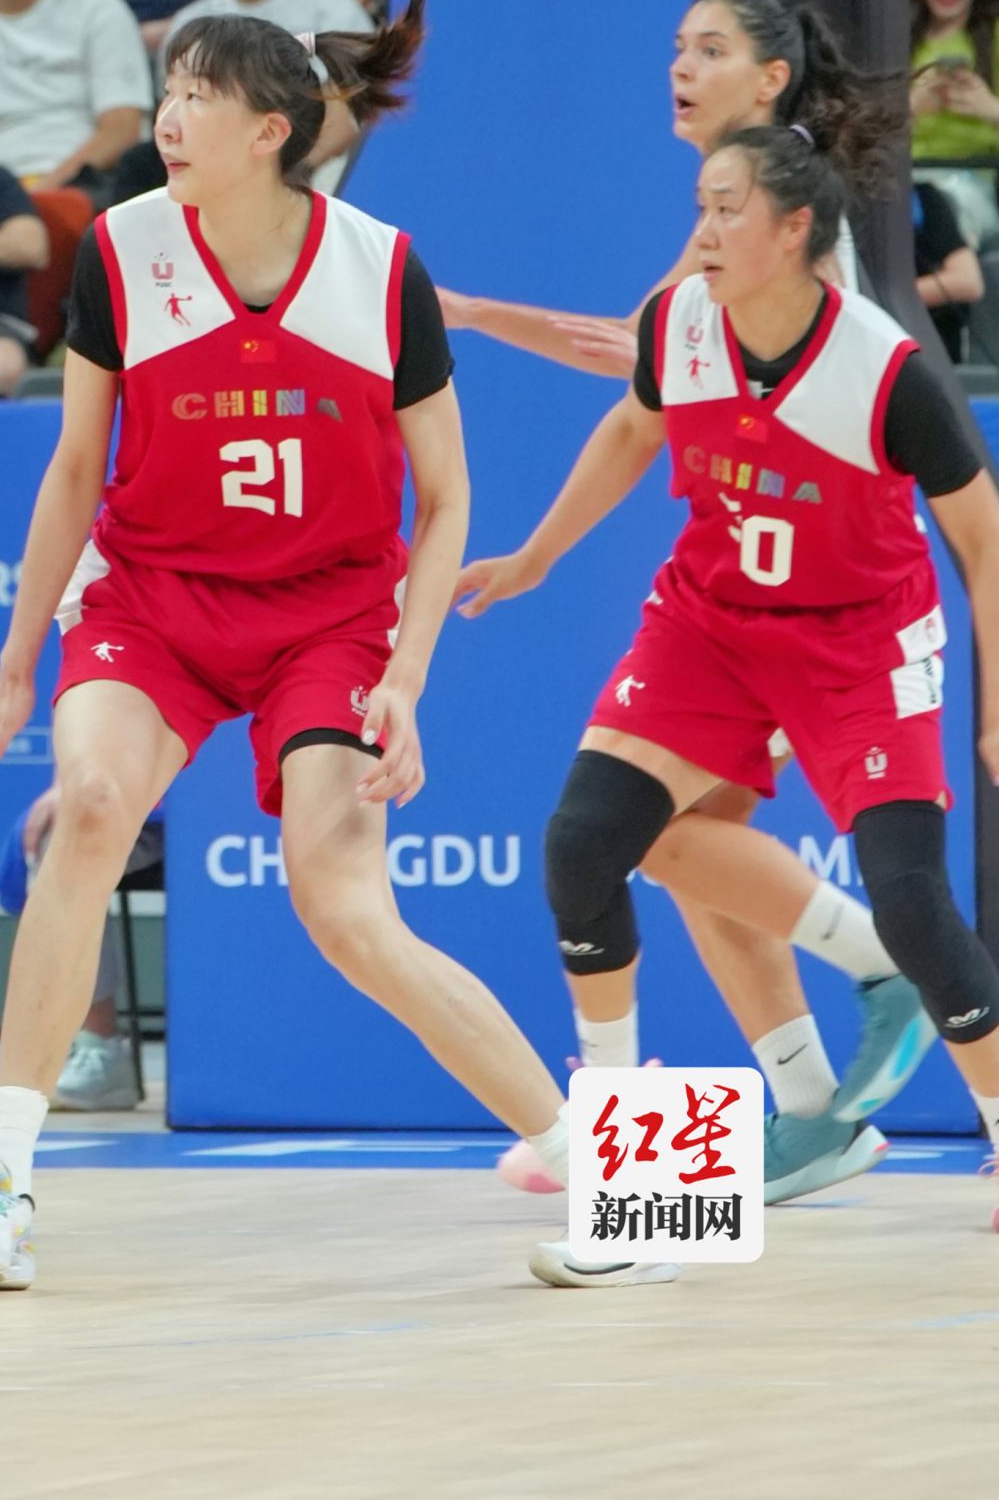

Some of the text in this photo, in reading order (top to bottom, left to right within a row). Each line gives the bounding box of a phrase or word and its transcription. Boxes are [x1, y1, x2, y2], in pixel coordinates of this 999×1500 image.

[219, 438, 303, 518] 21
[683, 444, 823, 504] CHINA
[205, 834, 521, 887] CHGDU
